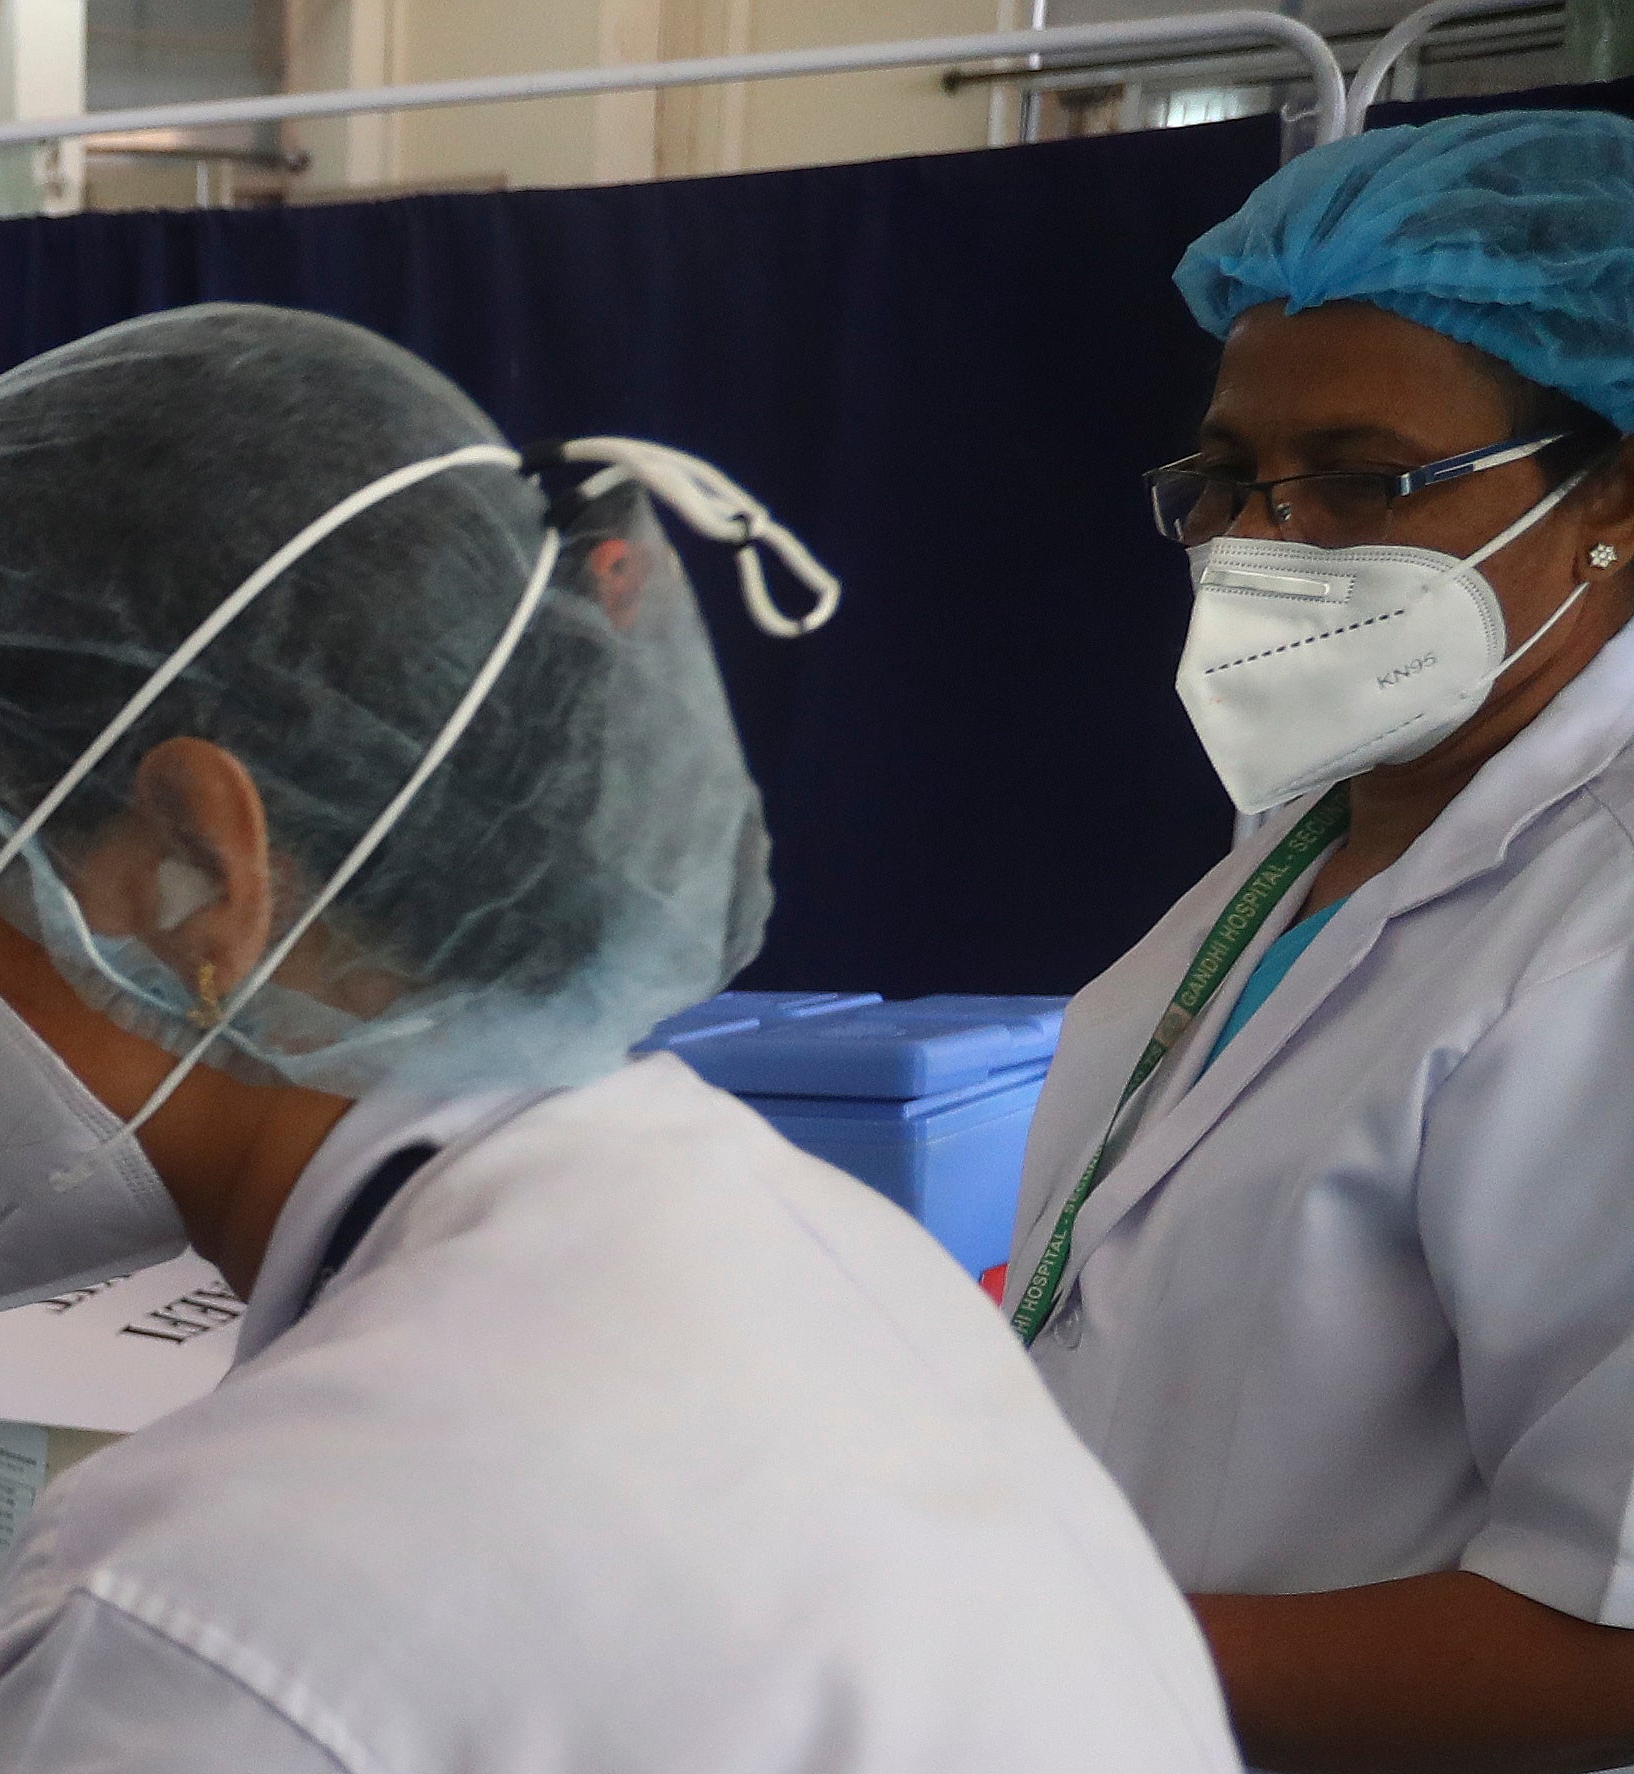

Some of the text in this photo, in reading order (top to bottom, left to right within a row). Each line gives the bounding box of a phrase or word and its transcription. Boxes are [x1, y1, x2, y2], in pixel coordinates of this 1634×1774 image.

[1376, 651, 1438, 690] KN95
[1179, 932, 1227, 1007] GANDHI
[1220, 863, 1292, 942] HOSPITAL
[1024, 1230, 1069, 1312] HOSPITAL
